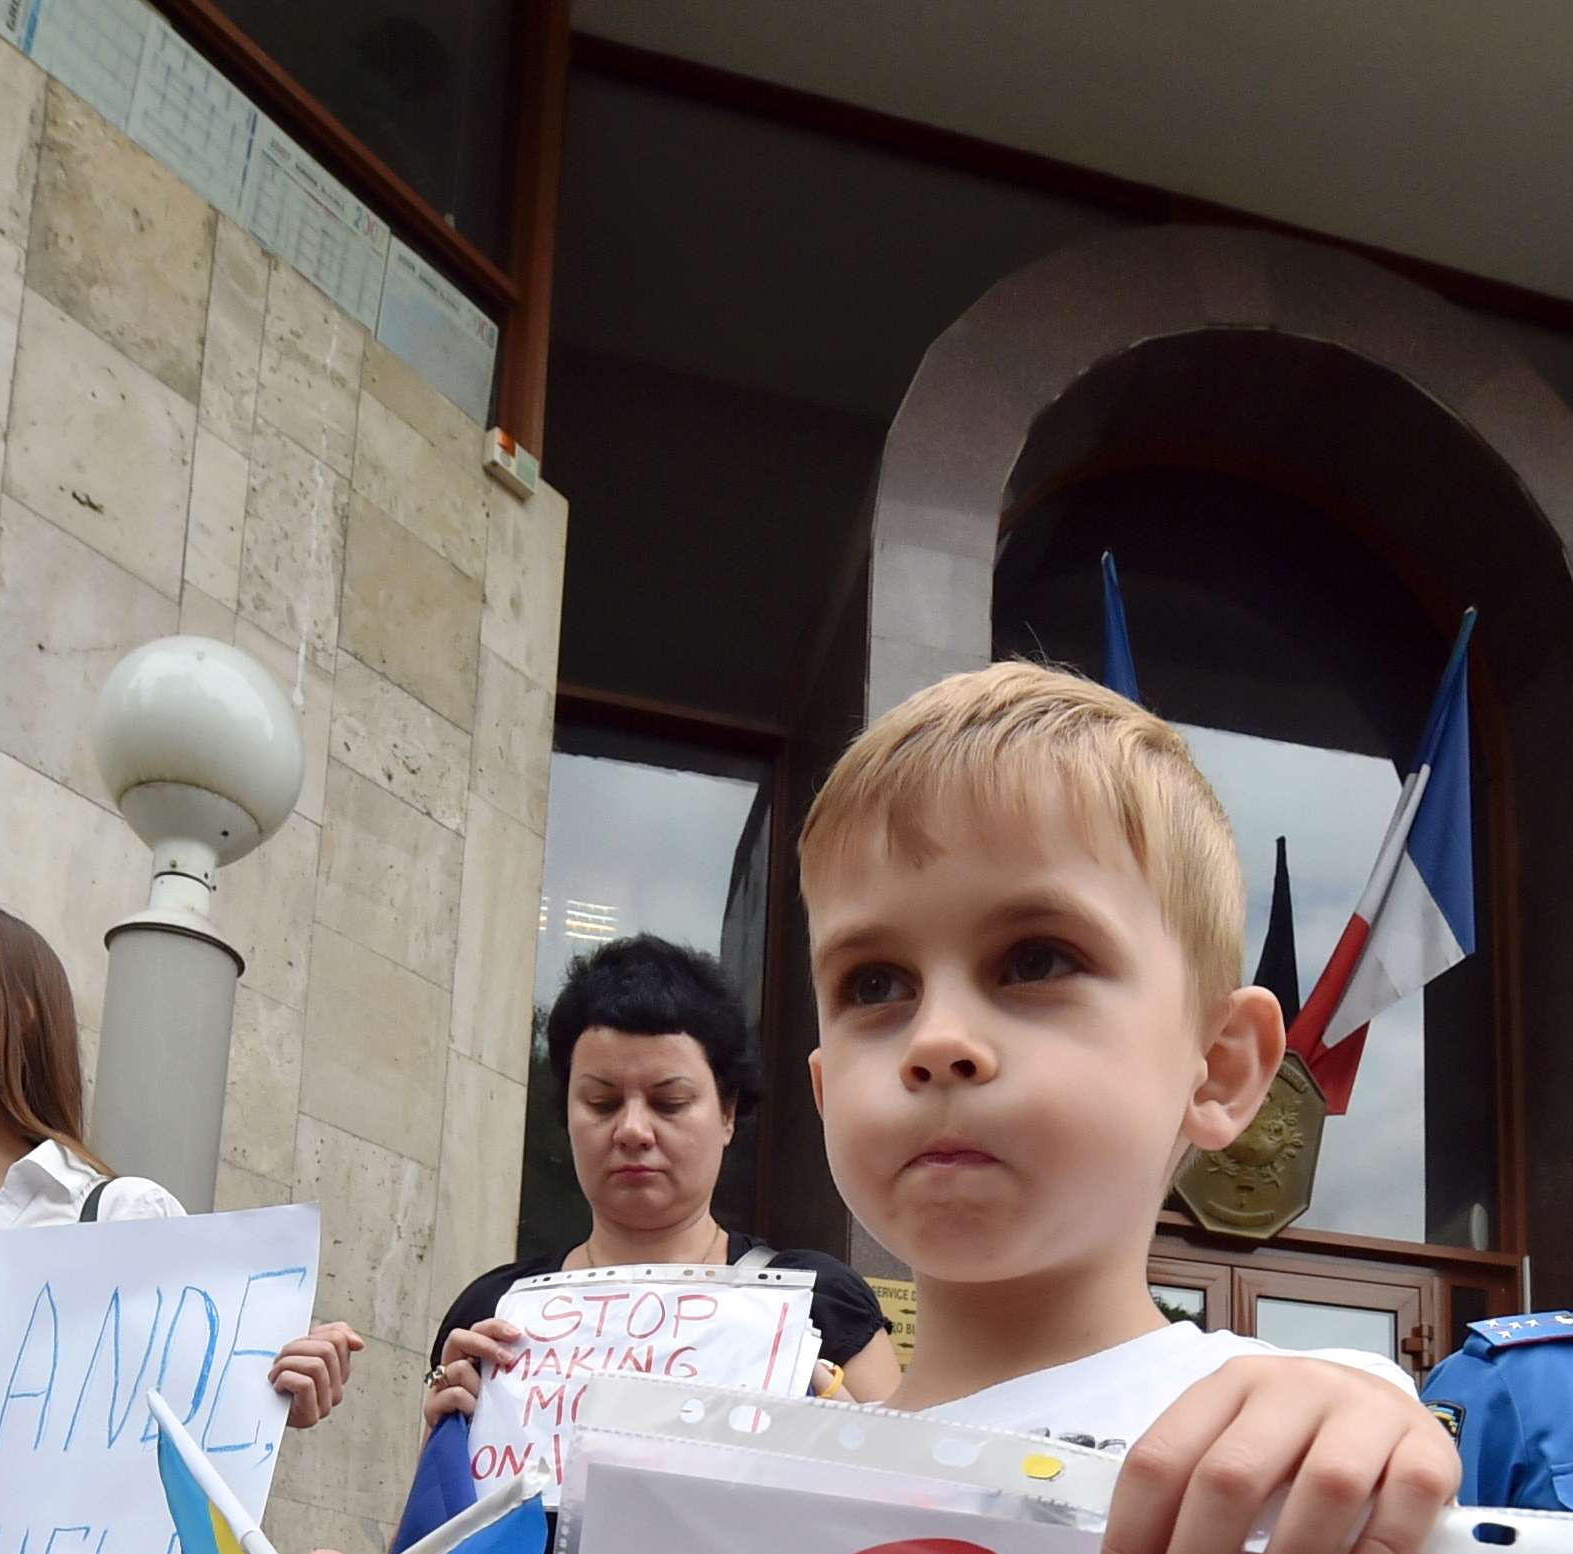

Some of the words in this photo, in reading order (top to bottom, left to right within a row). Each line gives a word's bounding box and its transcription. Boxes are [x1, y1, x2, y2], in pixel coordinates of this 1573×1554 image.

[524, 1291, 719, 1342] STOP
[490, 1345, 699, 1381] MAKING
[470, 1442, 535, 1481] ON
